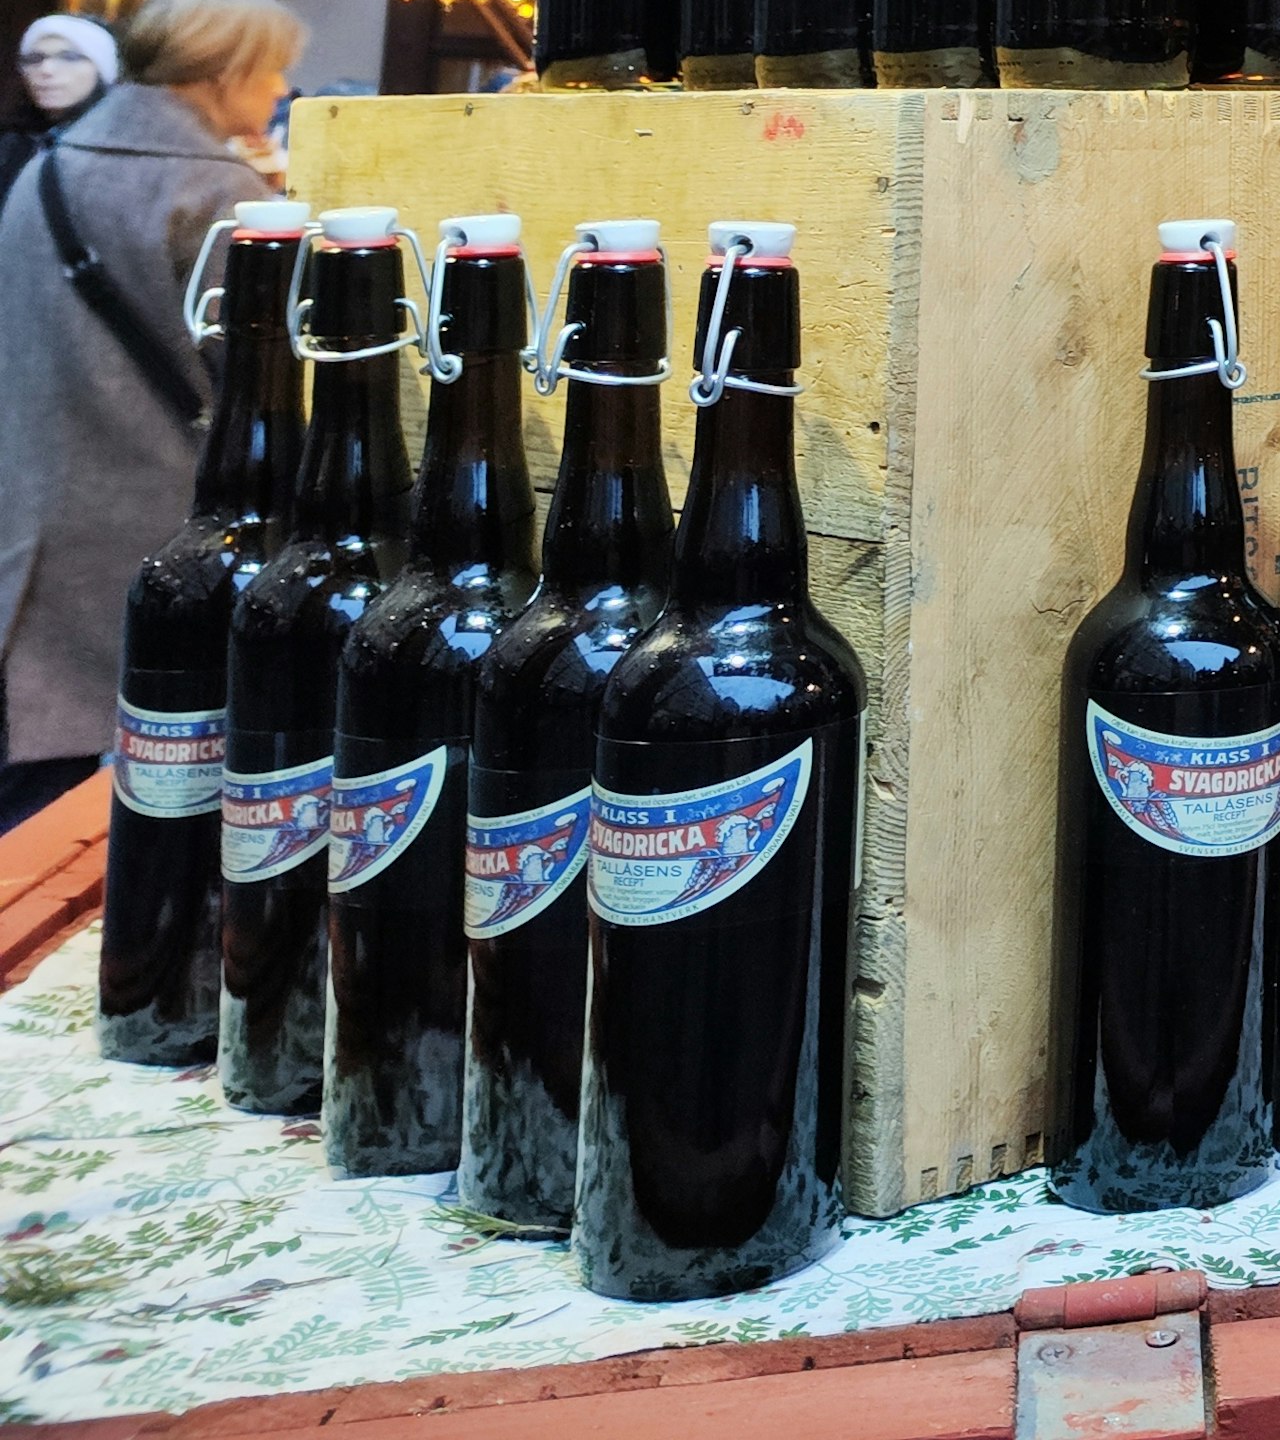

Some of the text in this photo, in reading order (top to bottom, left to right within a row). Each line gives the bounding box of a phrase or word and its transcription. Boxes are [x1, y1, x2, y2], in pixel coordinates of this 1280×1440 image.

[140, 724, 194, 737] KLASS
[128, 735, 226, 763] SVAGDRICK
[1190, 749, 1250, 766] KLASS
[1183, 791, 1274, 815] TALLÅSENS
[600, 805, 651, 826] KLASS
[591, 821, 707, 858] SVAGDRICKA
[597, 860, 682, 878] TALLÅSENS
